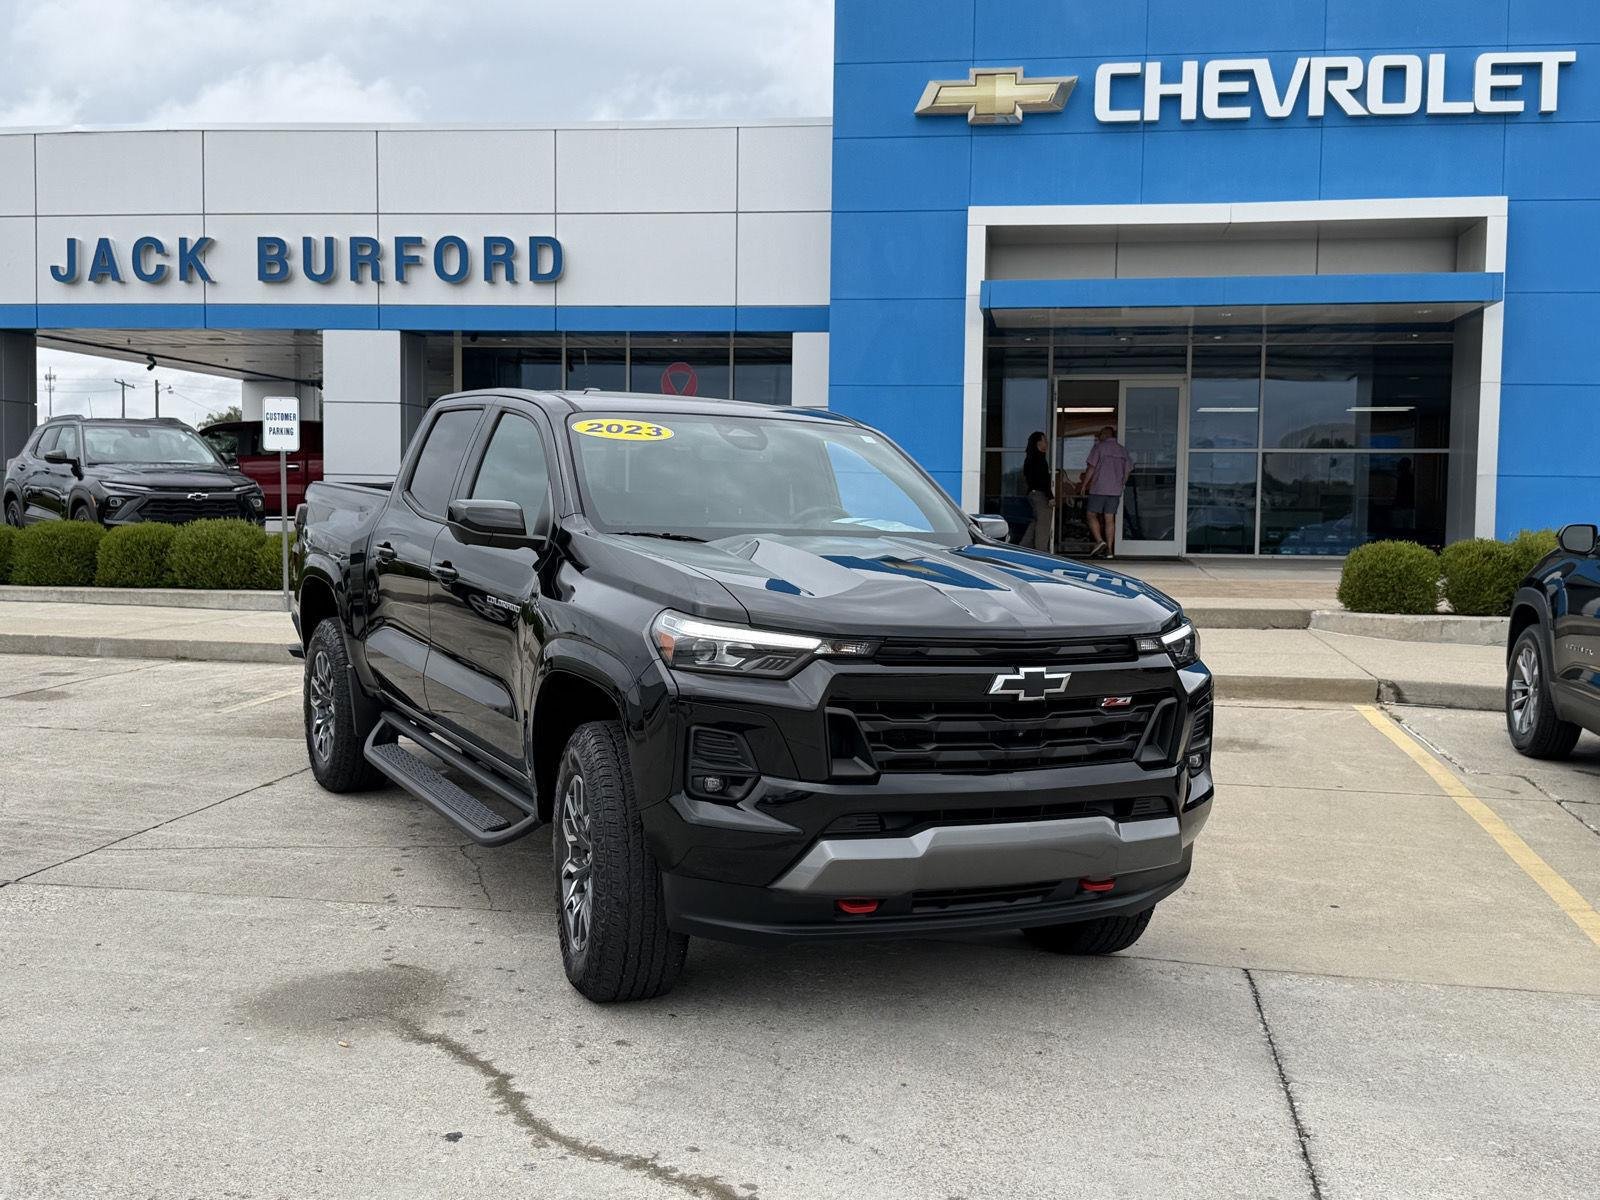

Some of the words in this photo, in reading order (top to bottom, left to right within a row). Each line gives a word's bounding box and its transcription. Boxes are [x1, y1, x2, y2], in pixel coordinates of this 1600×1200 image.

[1094, 51, 1577, 122] CHEVROLET
[50, 237, 215, 284] JACK
[257, 236, 564, 283] BURFORD
[265, 412, 297, 422] CUSTOMER
[268, 426, 294, 436] PARKING
[584, 422, 663, 437] 2023
